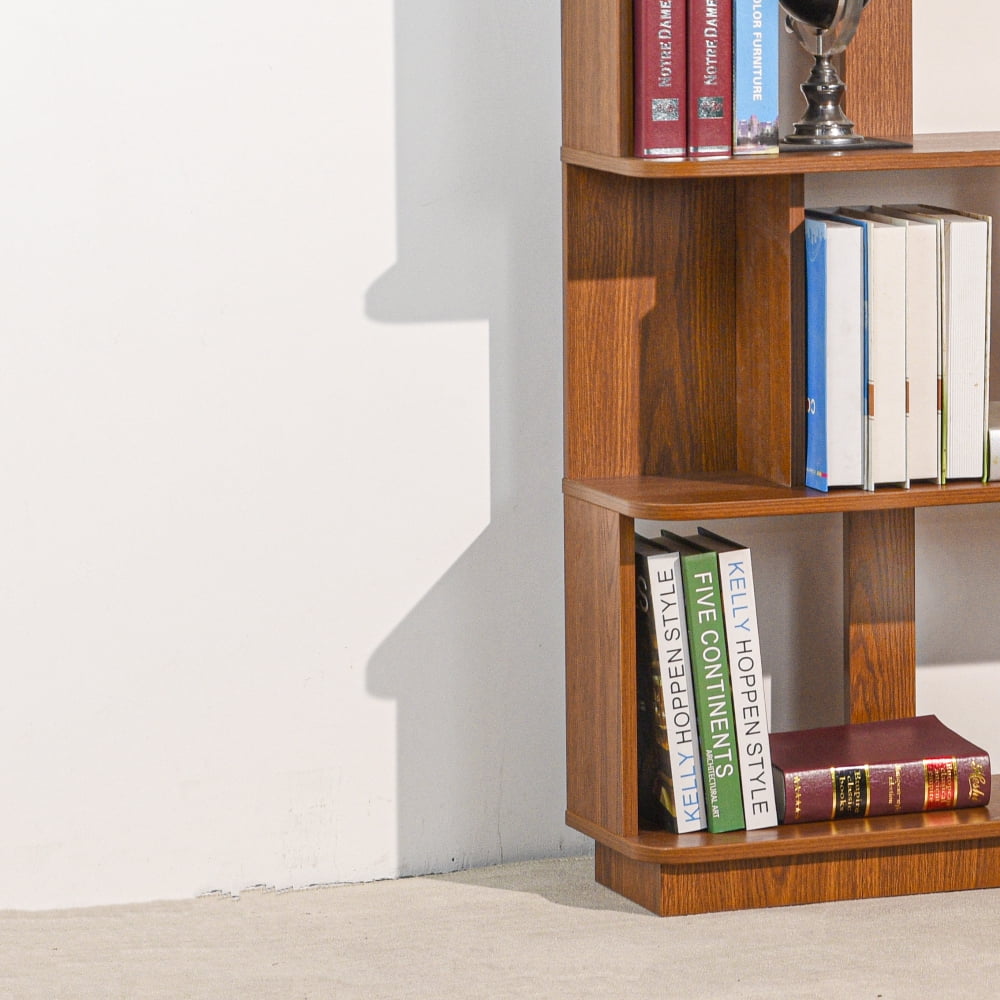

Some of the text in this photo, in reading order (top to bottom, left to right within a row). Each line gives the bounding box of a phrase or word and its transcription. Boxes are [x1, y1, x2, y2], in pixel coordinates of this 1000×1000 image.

[658, 0, 672, 87] NOTRE DAME
[704, 40, 718, 85] NOTRE
[753, 33, 763, 101] FURNITURE
[658, 569, 701, 822] KELLY HOPPEN STYLE
[694, 572, 734, 778] FIVE CONTINENTS
[728, 561, 768, 816] KELLY HOPPEN STYLE
[706, 749, 720, 818] ARCHITECTURAL ART
